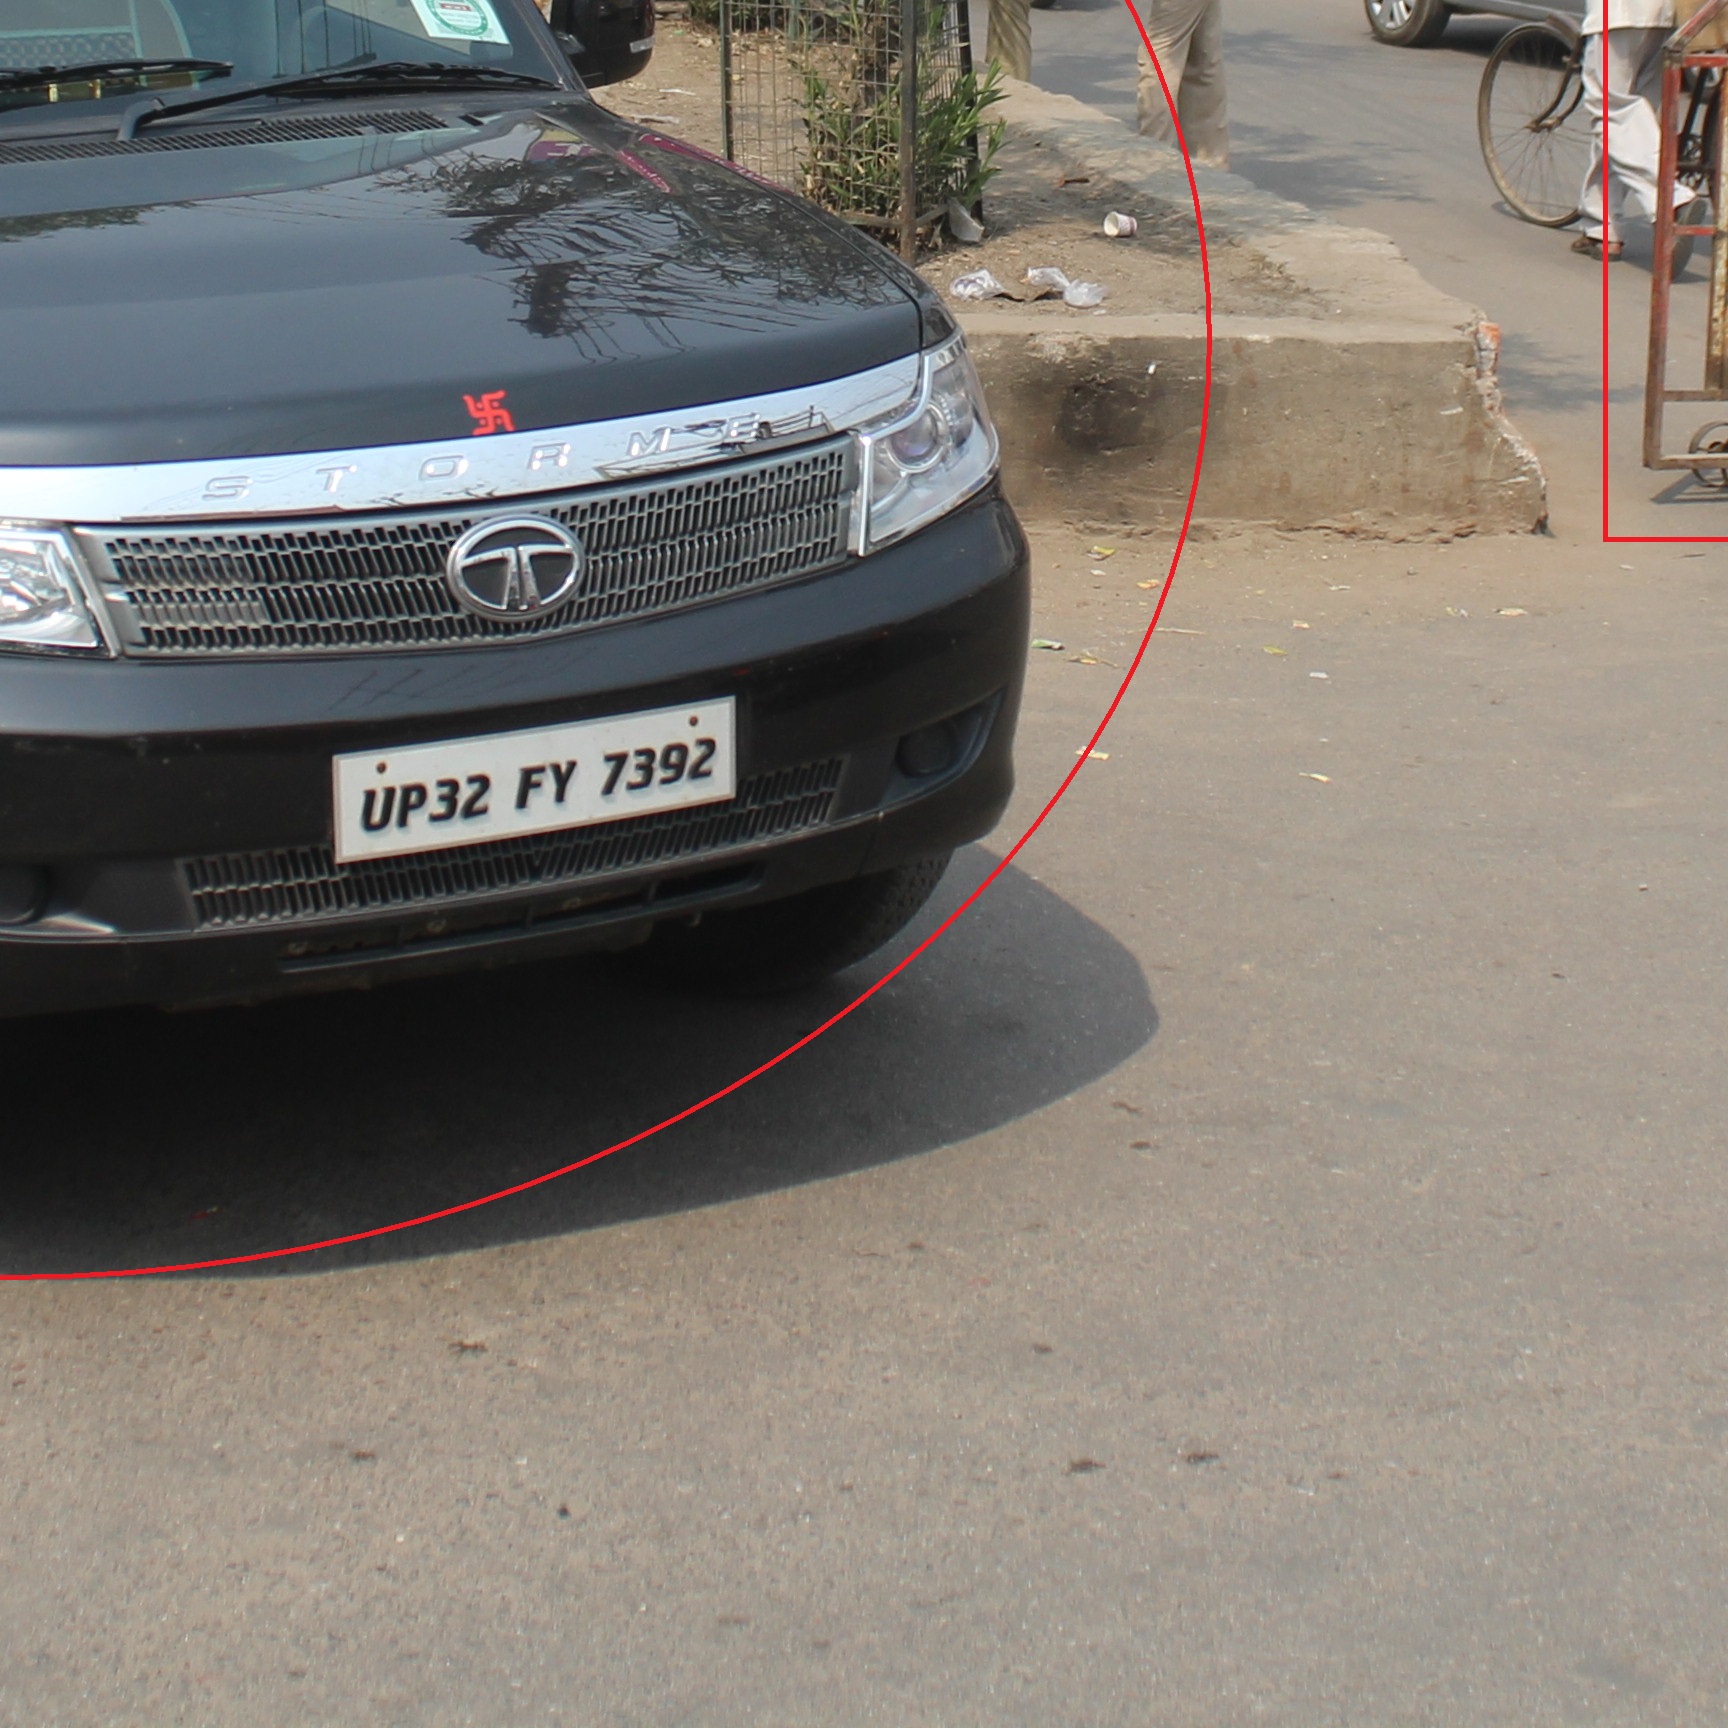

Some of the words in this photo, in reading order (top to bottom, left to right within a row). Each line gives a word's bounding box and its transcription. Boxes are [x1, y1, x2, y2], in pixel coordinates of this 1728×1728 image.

[201, 412, 763, 502] STORME
[361, 774, 491, 833] UP32
[515, 760, 577, 810] FY
[601, 738, 717, 796] 7392
